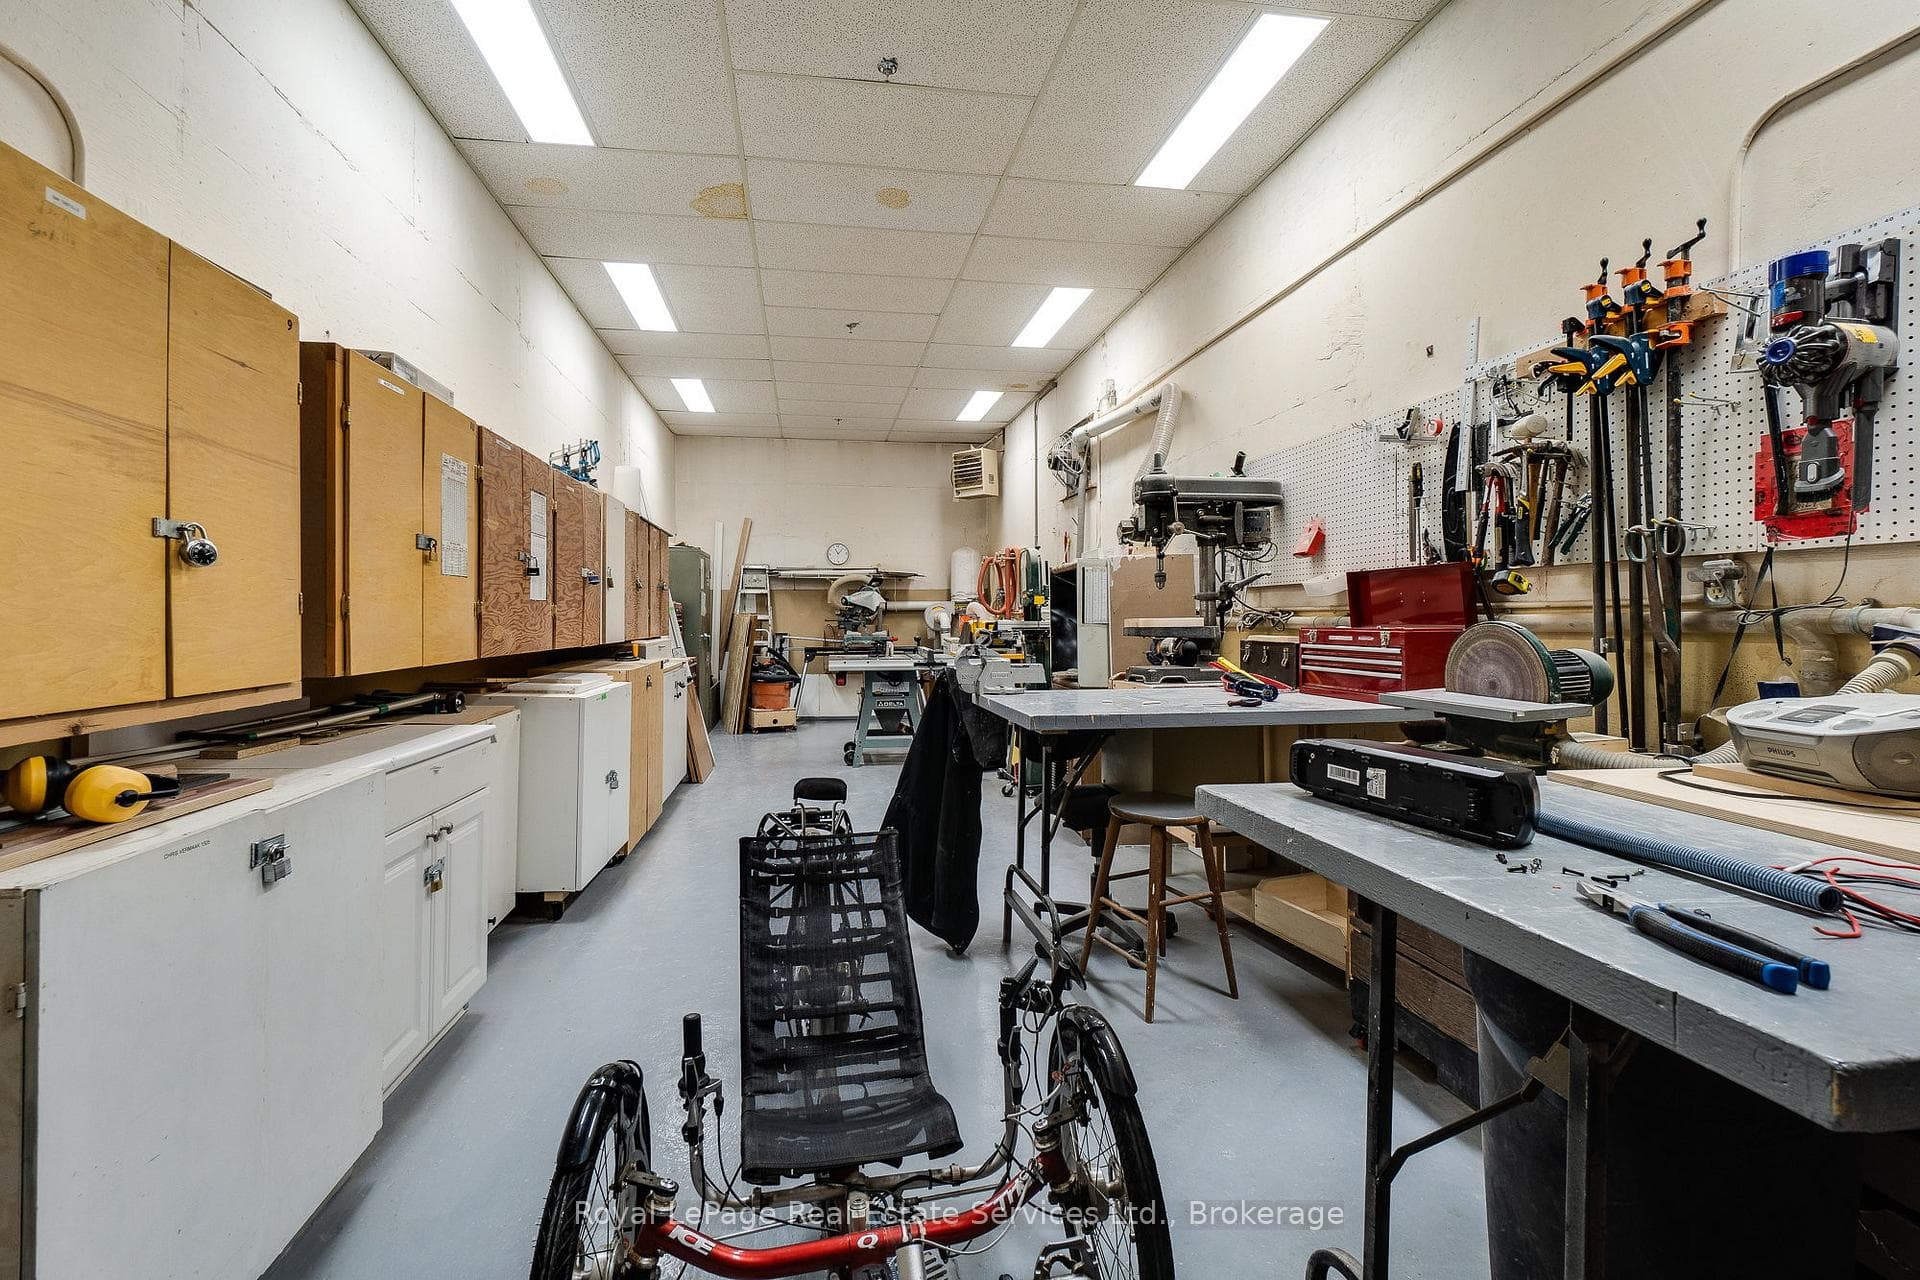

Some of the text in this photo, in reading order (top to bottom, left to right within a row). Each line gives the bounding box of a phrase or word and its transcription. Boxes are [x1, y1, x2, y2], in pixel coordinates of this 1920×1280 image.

[287, 319, 293, 331] 9
[1767, 747, 1796, 758] PHILIPS
[667, 1225, 716, 1256] ICE
[856, 1233, 879, 1249] Q
